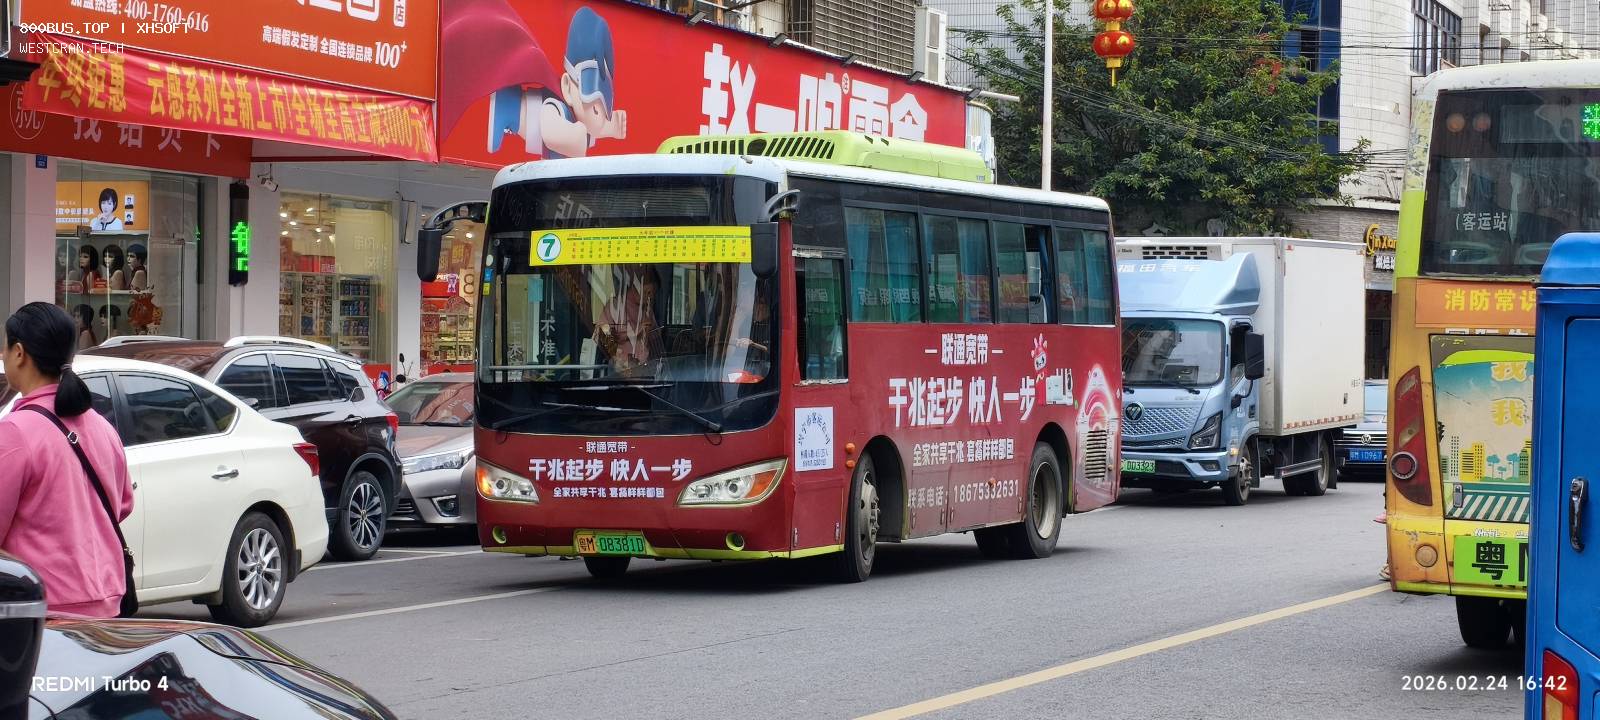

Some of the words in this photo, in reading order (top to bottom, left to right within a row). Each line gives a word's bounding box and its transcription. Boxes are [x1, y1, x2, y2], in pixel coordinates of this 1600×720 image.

[124, 0, 210, 33] 400-1760-616
[262, 25, 319, 53] 高端假发定制
[320, 38, 373, 63] 全国连锁品牌
[1455, 213, 1514, 232] (客运站)
[541, 238, 555, 257] 7
[942, 333, 989, 366] 联通宽带
[888, 376, 963, 427] 千兆起步
[968, 375, 1036, 425] 快人一步
[586, 441, 628, 453] 联通宽带
[913, 443, 965, 466] 全家共享千兆
[967, 438, 1014, 463] 套餐样样都包
[529, 458, 604, 482] 千兆起步
[610, 458, 692, 482] 快人一步
[553, 487, 607, 498] 全家共享千兆
[953, 479, 1019, 503] 18675332631
